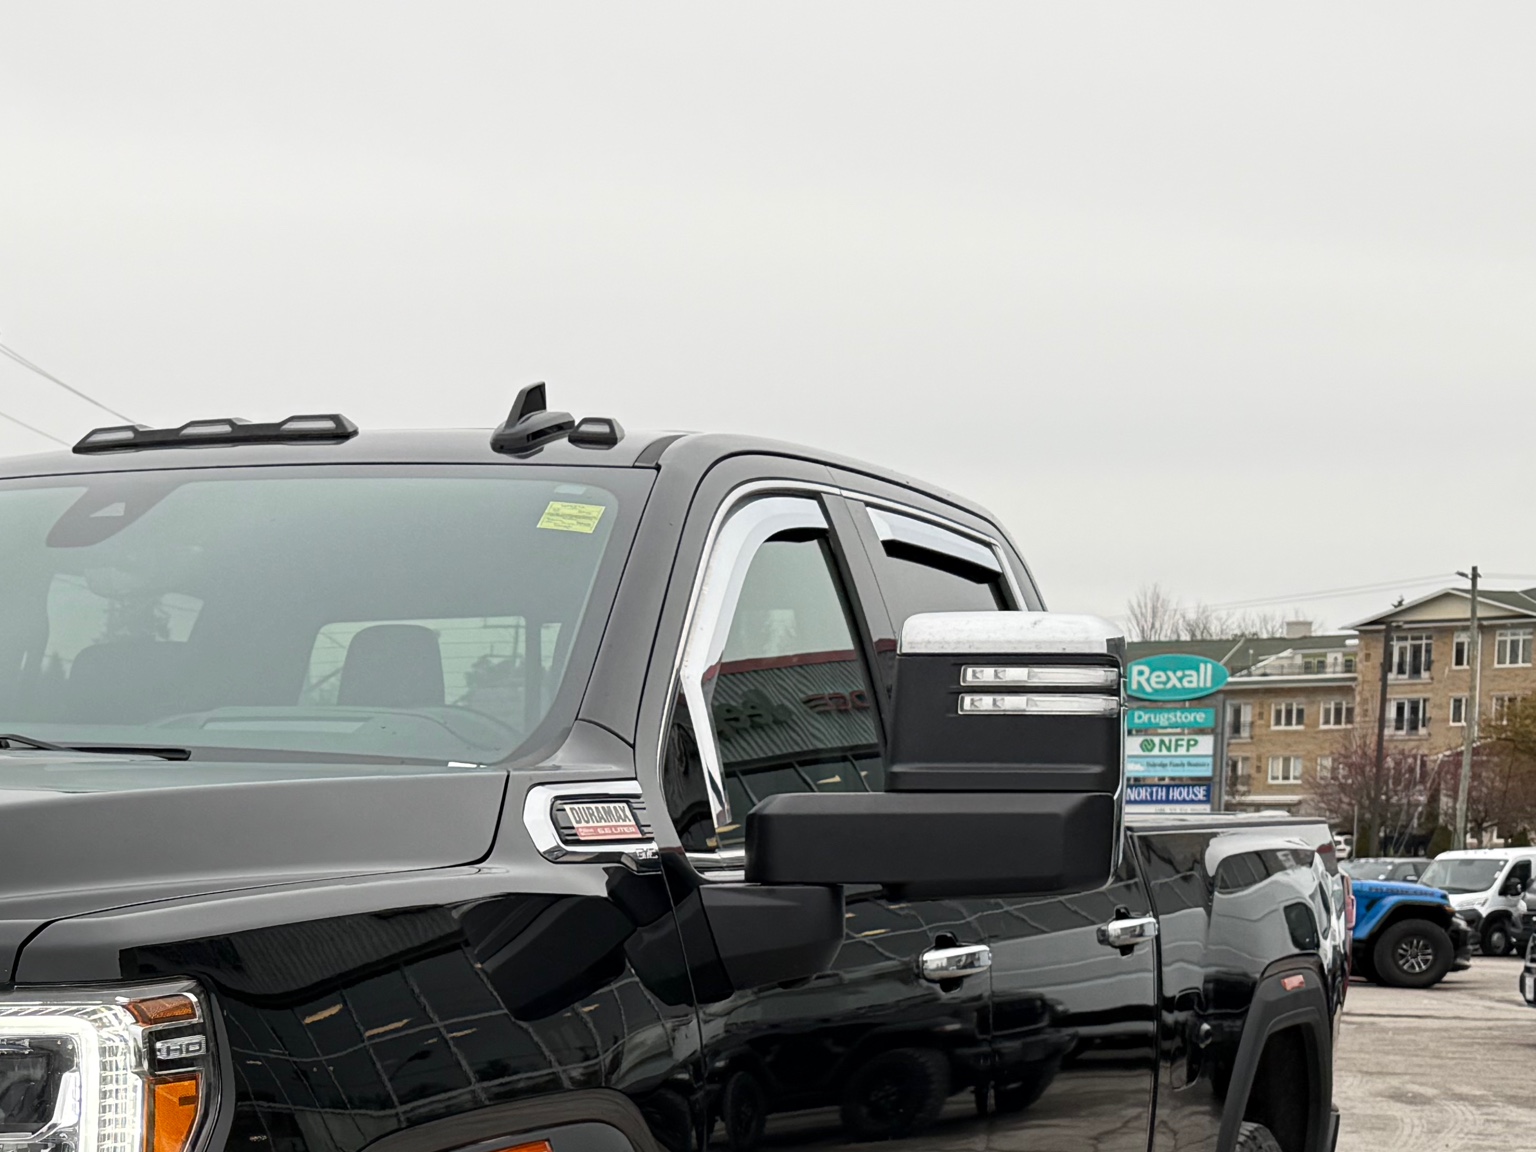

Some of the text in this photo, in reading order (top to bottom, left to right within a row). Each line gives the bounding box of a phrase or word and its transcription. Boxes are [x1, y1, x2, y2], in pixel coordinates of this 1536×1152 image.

[1130, 663, 1213, 692] Rexall
[1133, 711, 1206, 726] Drugstore
[1158, 738, 1199, 753] NFP
[1126, 785, 1207, 801] NORTH HOUSE
[569, 805, 632, 825] DURAMAX
[612, 826, 636, 834] LITER
[166, 1040, 202, 1057] HD
